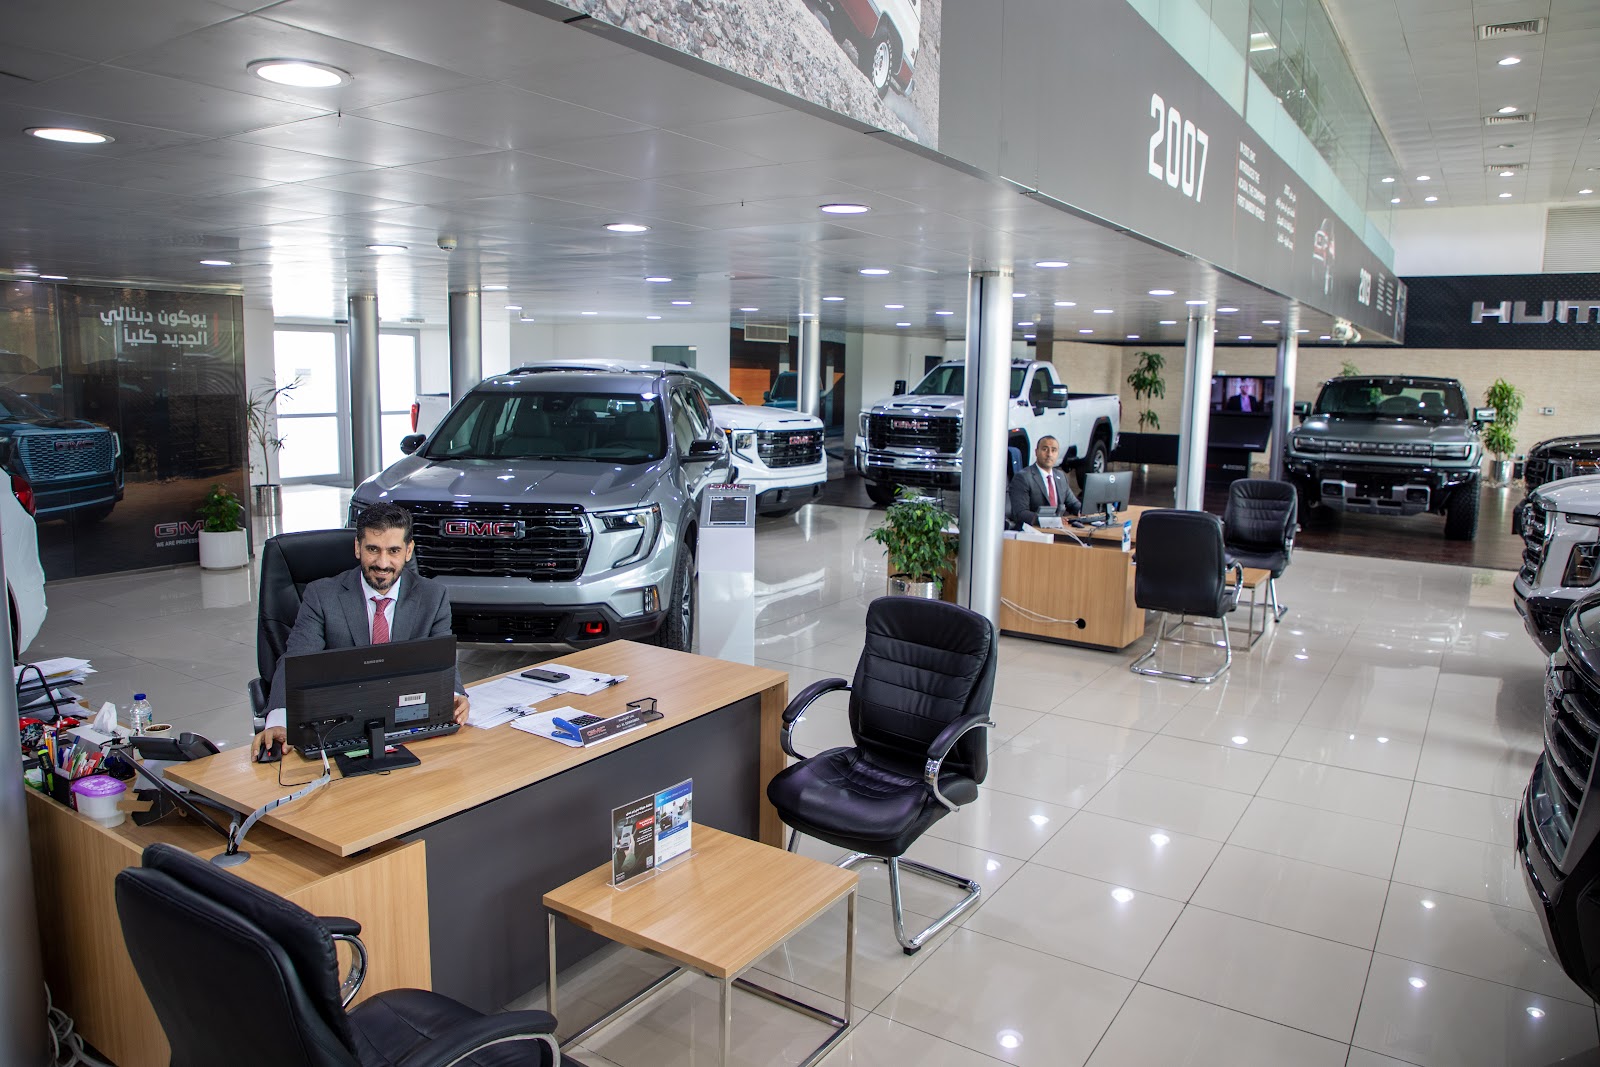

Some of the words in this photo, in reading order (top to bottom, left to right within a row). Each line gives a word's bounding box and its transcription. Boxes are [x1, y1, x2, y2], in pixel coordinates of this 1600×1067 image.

[1148, 93, 1209, 202] 2007
[100, 307, 153, 326] دينالي
[158, 310, 207, 328] يوكون
[162, 331, 207, 348] الجديد
[893, 420, 929, 429] GMC
[789, 436, 814, 445] GMC
[154, 520, 208, 538] GM
[445, 521, 516, 536] GMC
[586, 725, 607, 737] GMC
